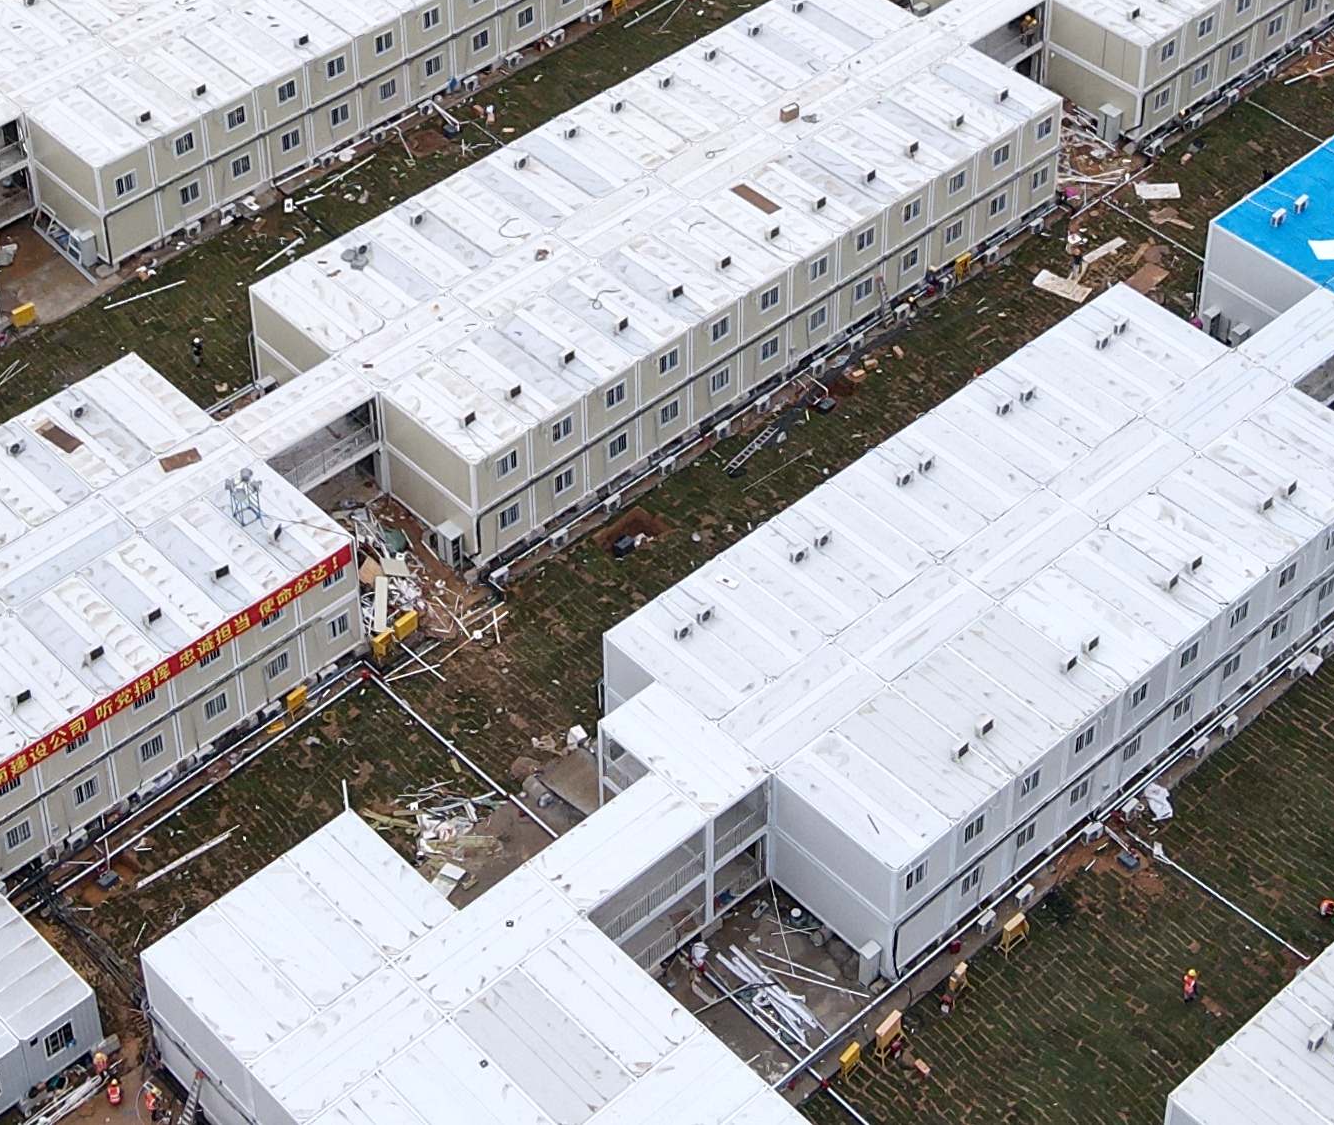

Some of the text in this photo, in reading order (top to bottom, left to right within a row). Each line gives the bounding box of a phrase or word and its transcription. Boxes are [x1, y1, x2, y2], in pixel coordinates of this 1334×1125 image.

[95, 662, 171, 721] 听党指挥
[178, 613, 251, 667] 忠诚担当
